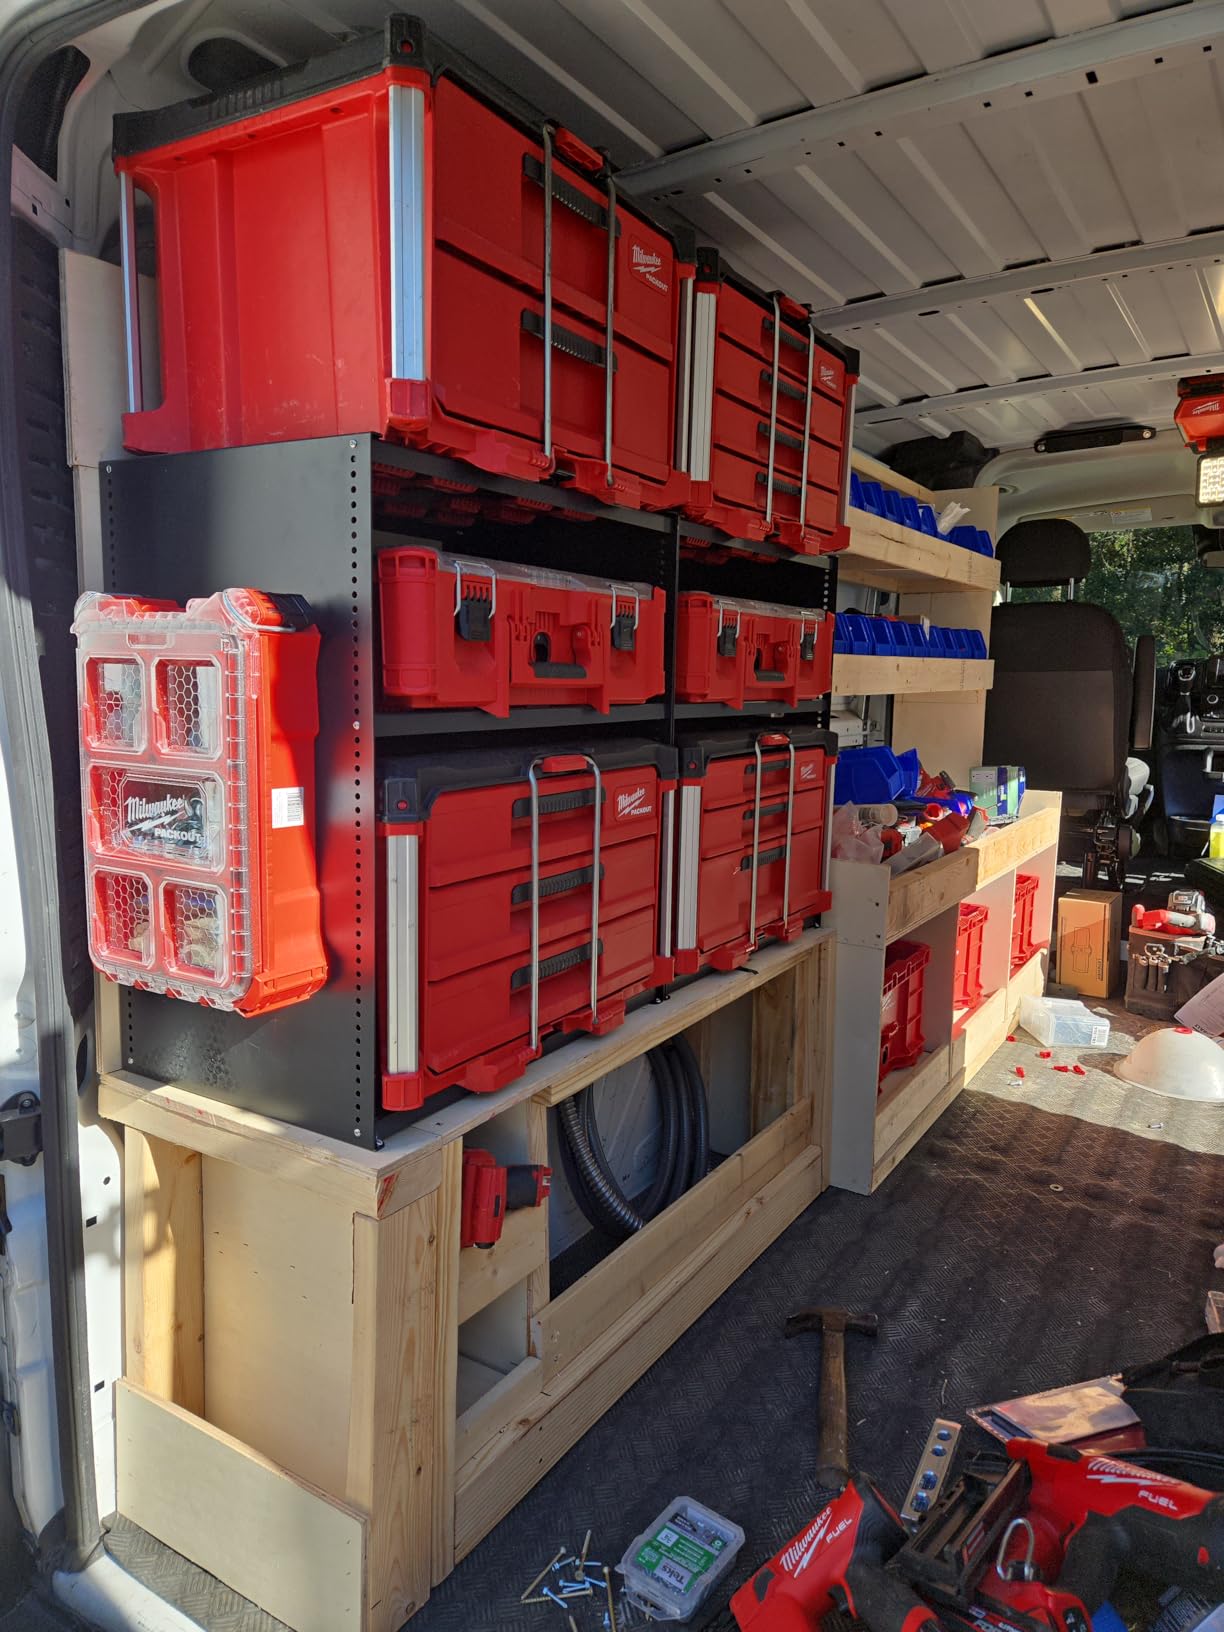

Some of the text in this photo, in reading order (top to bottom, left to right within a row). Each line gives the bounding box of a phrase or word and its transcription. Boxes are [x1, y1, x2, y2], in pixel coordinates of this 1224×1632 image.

[124, 794, 184, 823] Milwaukee
[631, 805, 653, 816] PACKOUT
[154, 827, 202, 842] PACKOUT
[1138, 1489, 1178, 1511] FUEL
[779, 1506, 832, 1572] Milwaukee
[825, 1518, 853, 1544] FUEL
[662, 1564, 685, 1585] Teks
